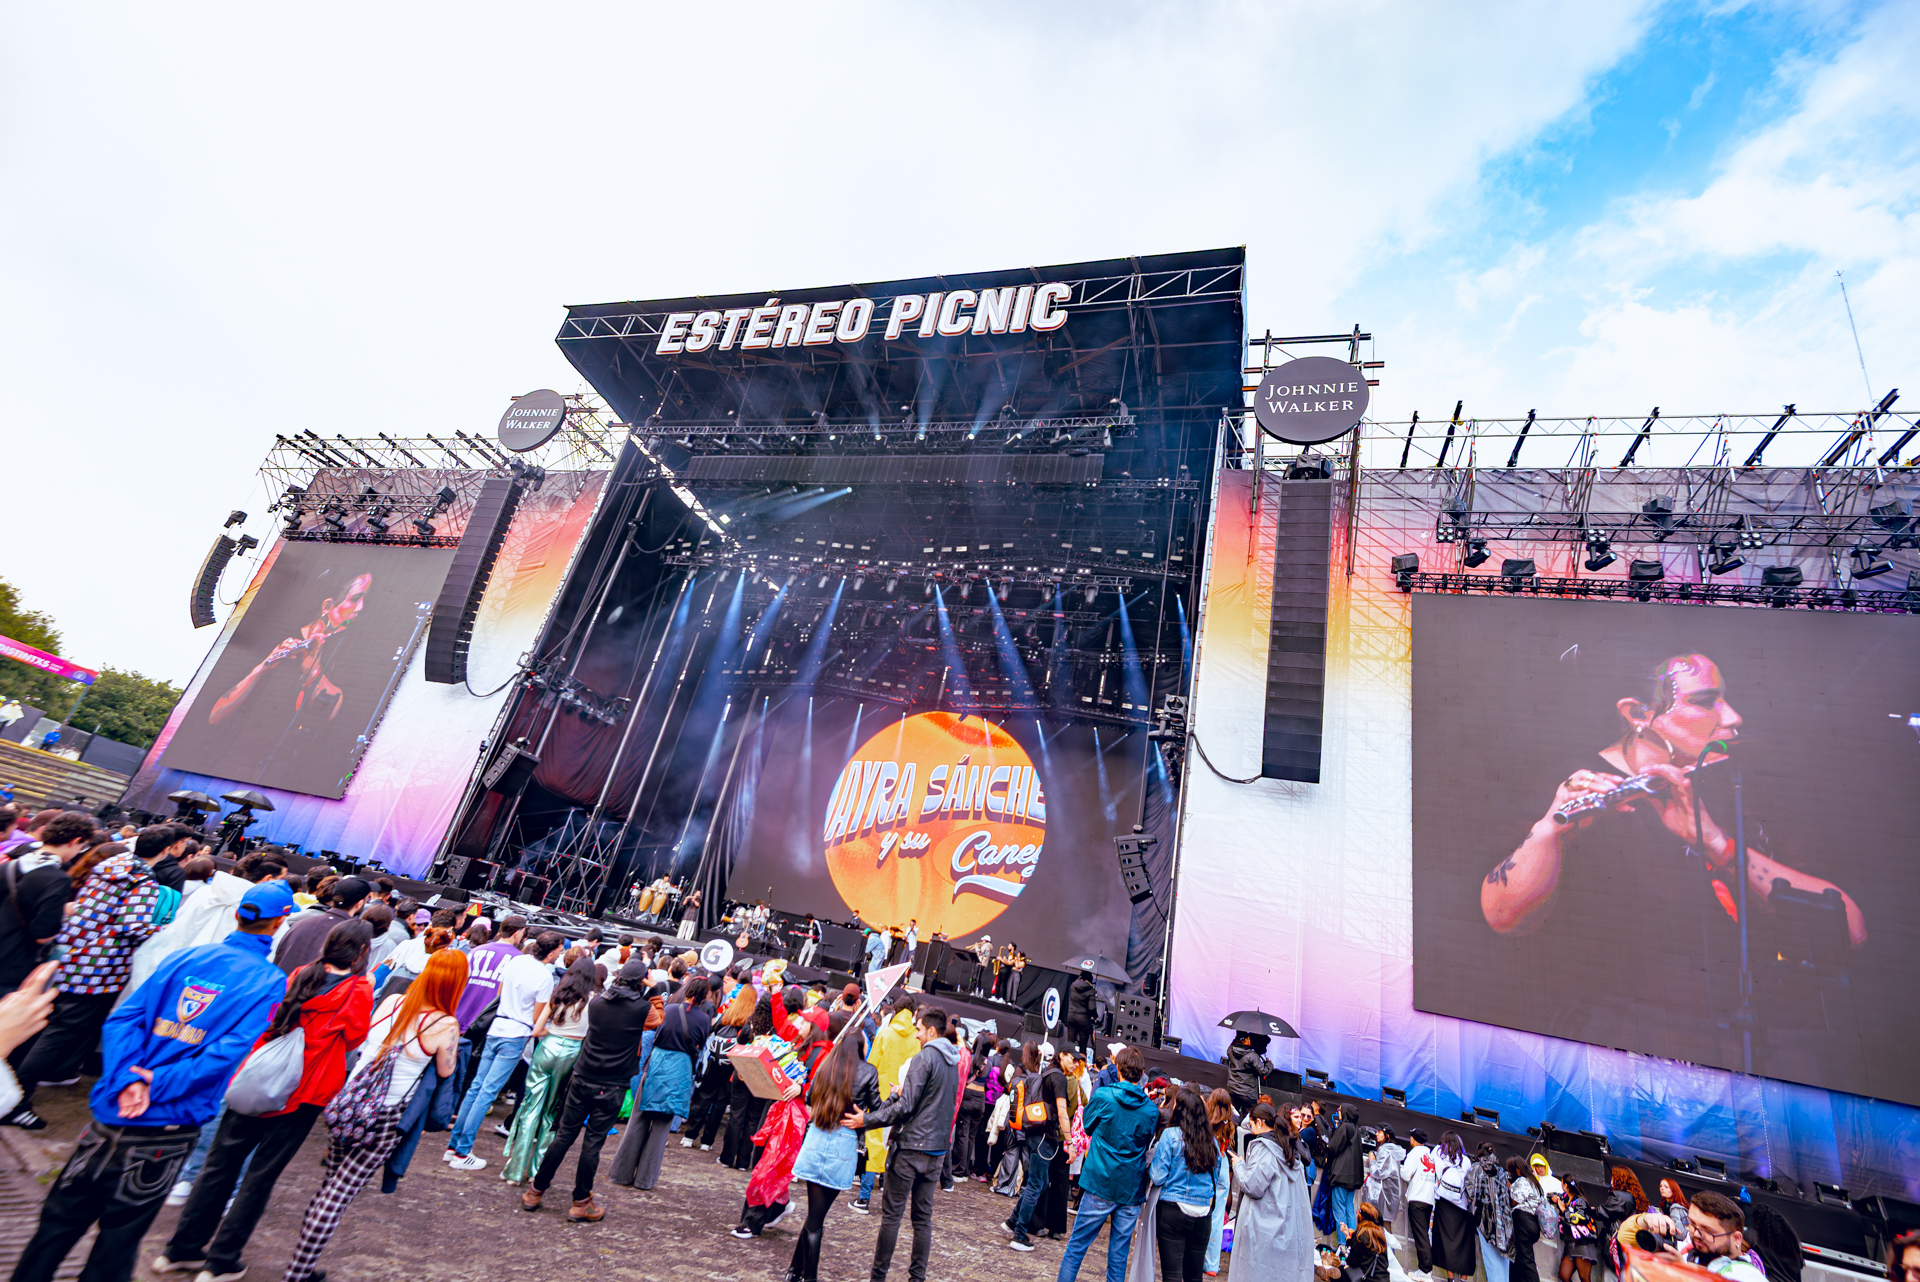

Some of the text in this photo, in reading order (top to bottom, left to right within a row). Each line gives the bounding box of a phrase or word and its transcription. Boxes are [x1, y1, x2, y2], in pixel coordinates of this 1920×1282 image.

[655, 282, 1073, 356] ESTÉREO PICNIC
[1264, 381, 1359, 401] JOHNNIE
[506, 407, 560, 420] JOHNNIE
[1267, 399, 1355, 414] WALKER
[505, 419, 552, 429] WALKER
[878, 831, 899, 861] y
[899, 830, 931, 851] su
